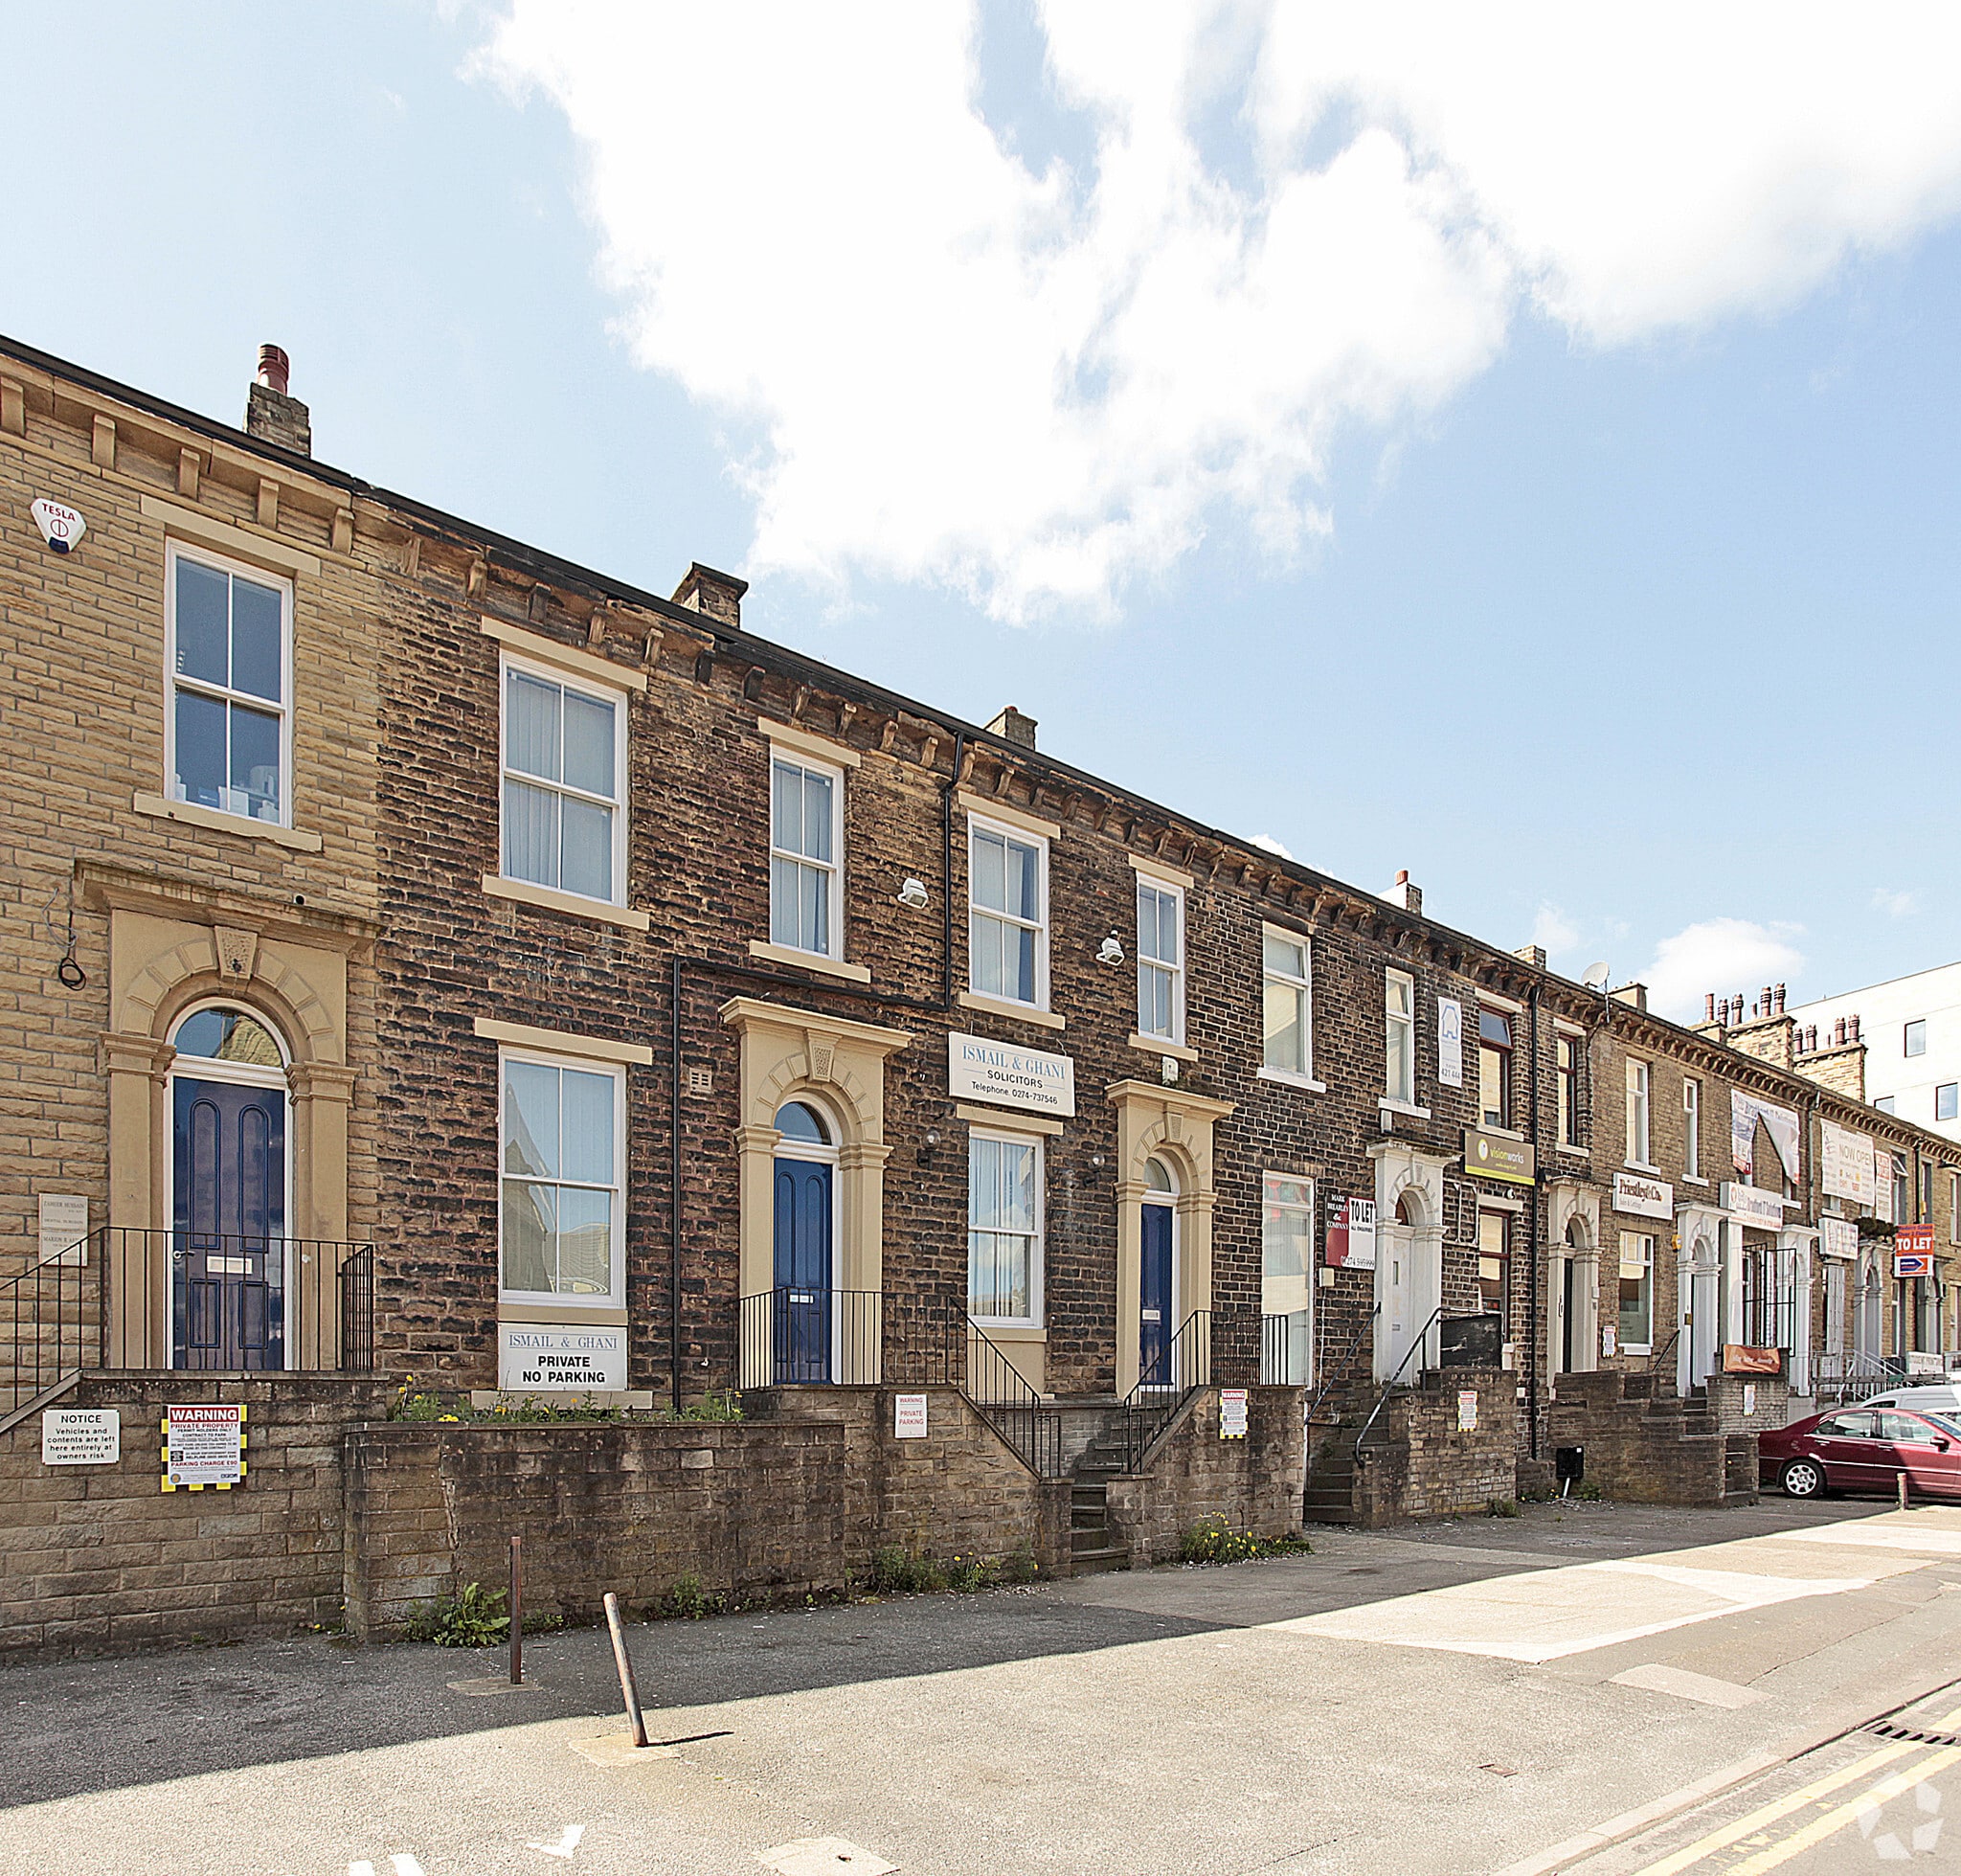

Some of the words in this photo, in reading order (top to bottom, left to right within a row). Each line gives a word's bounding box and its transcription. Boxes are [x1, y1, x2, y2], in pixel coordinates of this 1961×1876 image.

[41, 503, 77, 522] TESLA
[962, 1045, 1008, 1068] ISMAIL
[1012, 1056, 1022, 1071] &
[1026, 1058, 1065, 1079] GHANI
[987, 1070, 1044, 1089] SOLICITORS
[1011, 1089, 1058, 1105] 0274-737546
[1490, 1146, 1524, 1164] visionworks
[1838, 1144, 1856, 1162] NOW
[1857, 1149, 1874, 1165] OPEN
[1331, 1193, 1345, 1203] MARK
[1351, 1200, 1360, 1222] TO
[1362, 1202, 1374, 1224] LET
[1326, 1221, 1348, 1231] COMPANY
[1896, 1237, 1911, 1251] TO
[1913, 1236, 1932, 1250] LET
[508, 1334, 553, 1347] ISMAIL
[560, 1336, 570, 1347] &
[577, 1336, 618, 1349] GHANI
[538, 1355, 591, 1367] PRIVATE
[523, 1370, 541, 1383] NO
[548, 1371, 605, 1383] PARKING
[60, 1414, 102, 1424] NOTICE
[170, 1410, 237, 1421] WARNING
